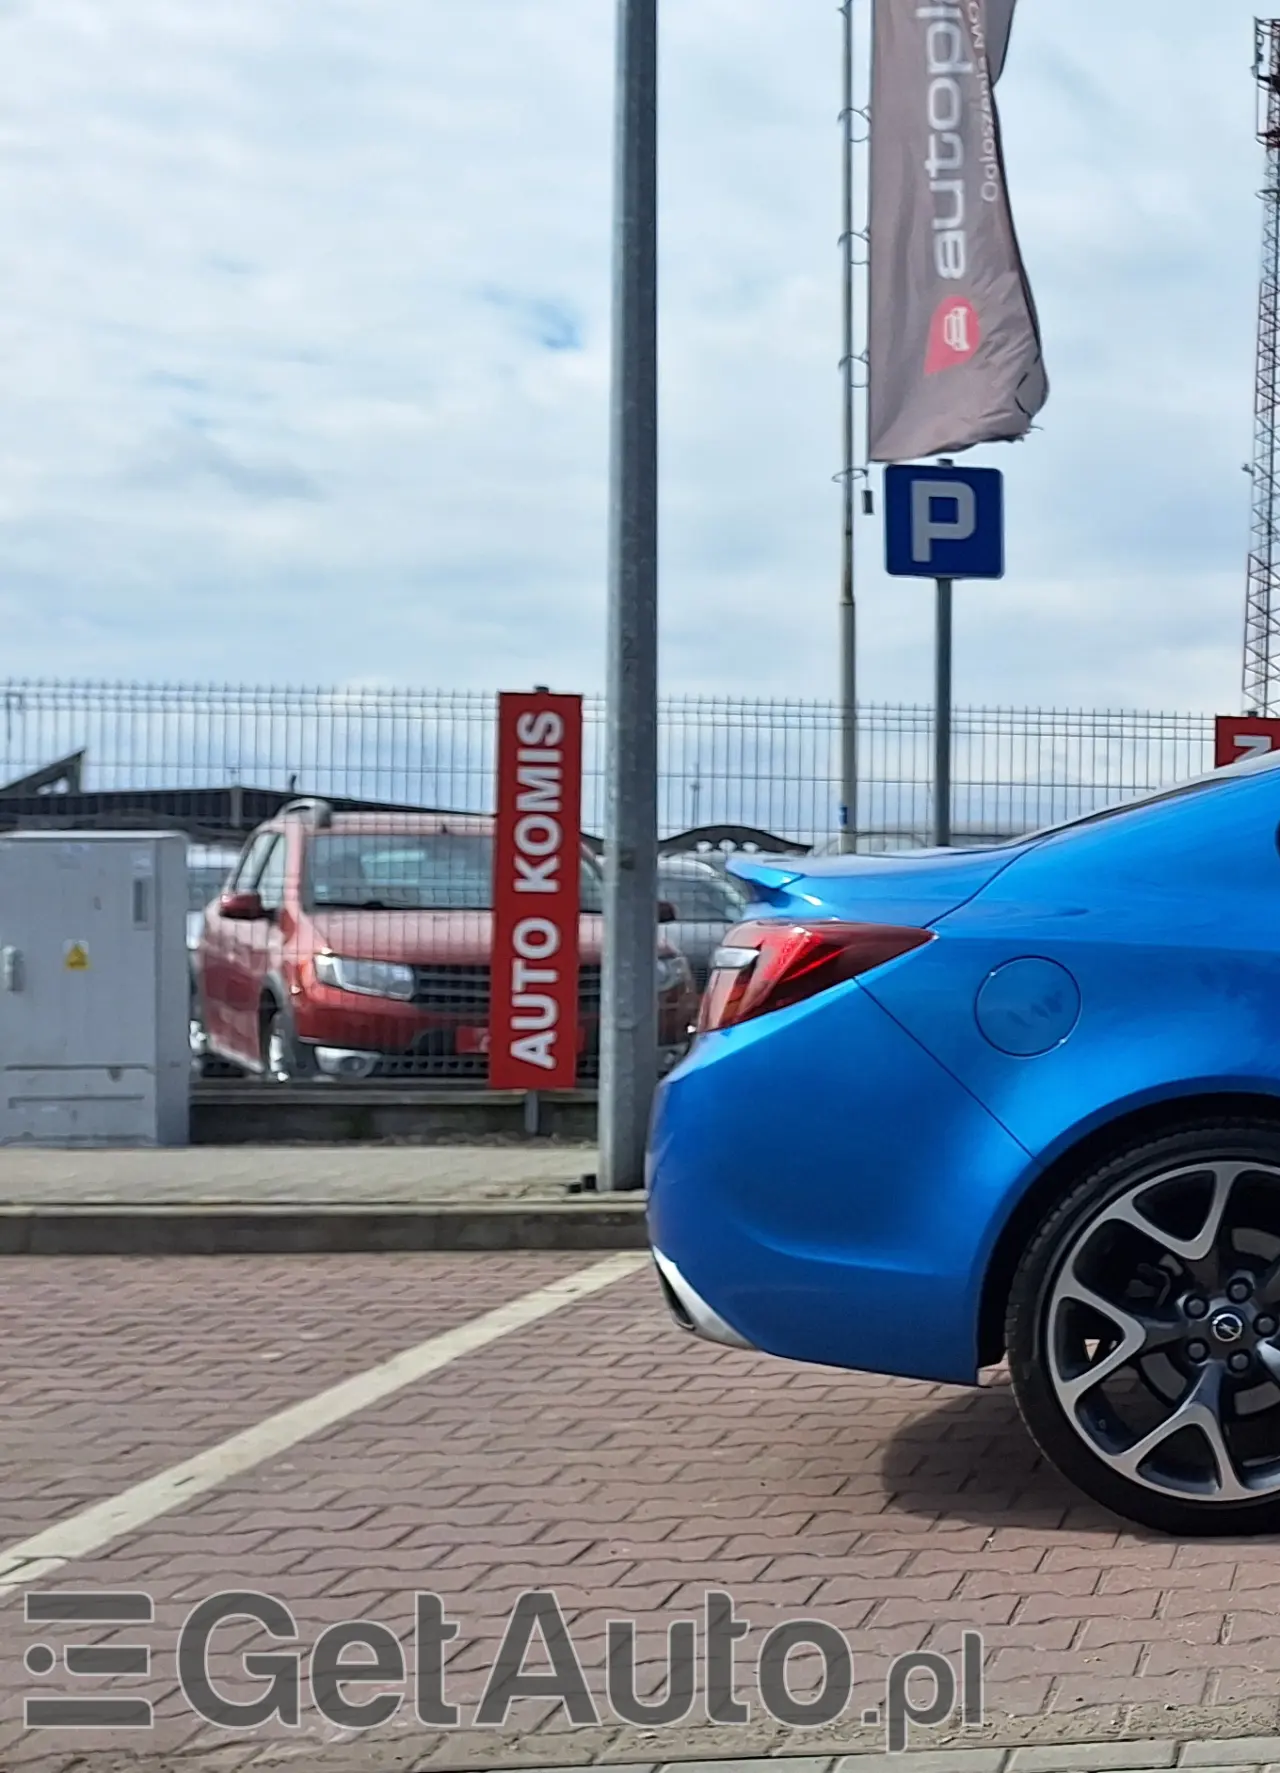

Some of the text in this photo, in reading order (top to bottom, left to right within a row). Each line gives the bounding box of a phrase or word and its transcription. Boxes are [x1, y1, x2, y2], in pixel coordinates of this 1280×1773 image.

[916, 0, 973, 281] autopl
[911, 480, 976, 562] P
[510, 710, 564, 1070] AUTO KOMIS
